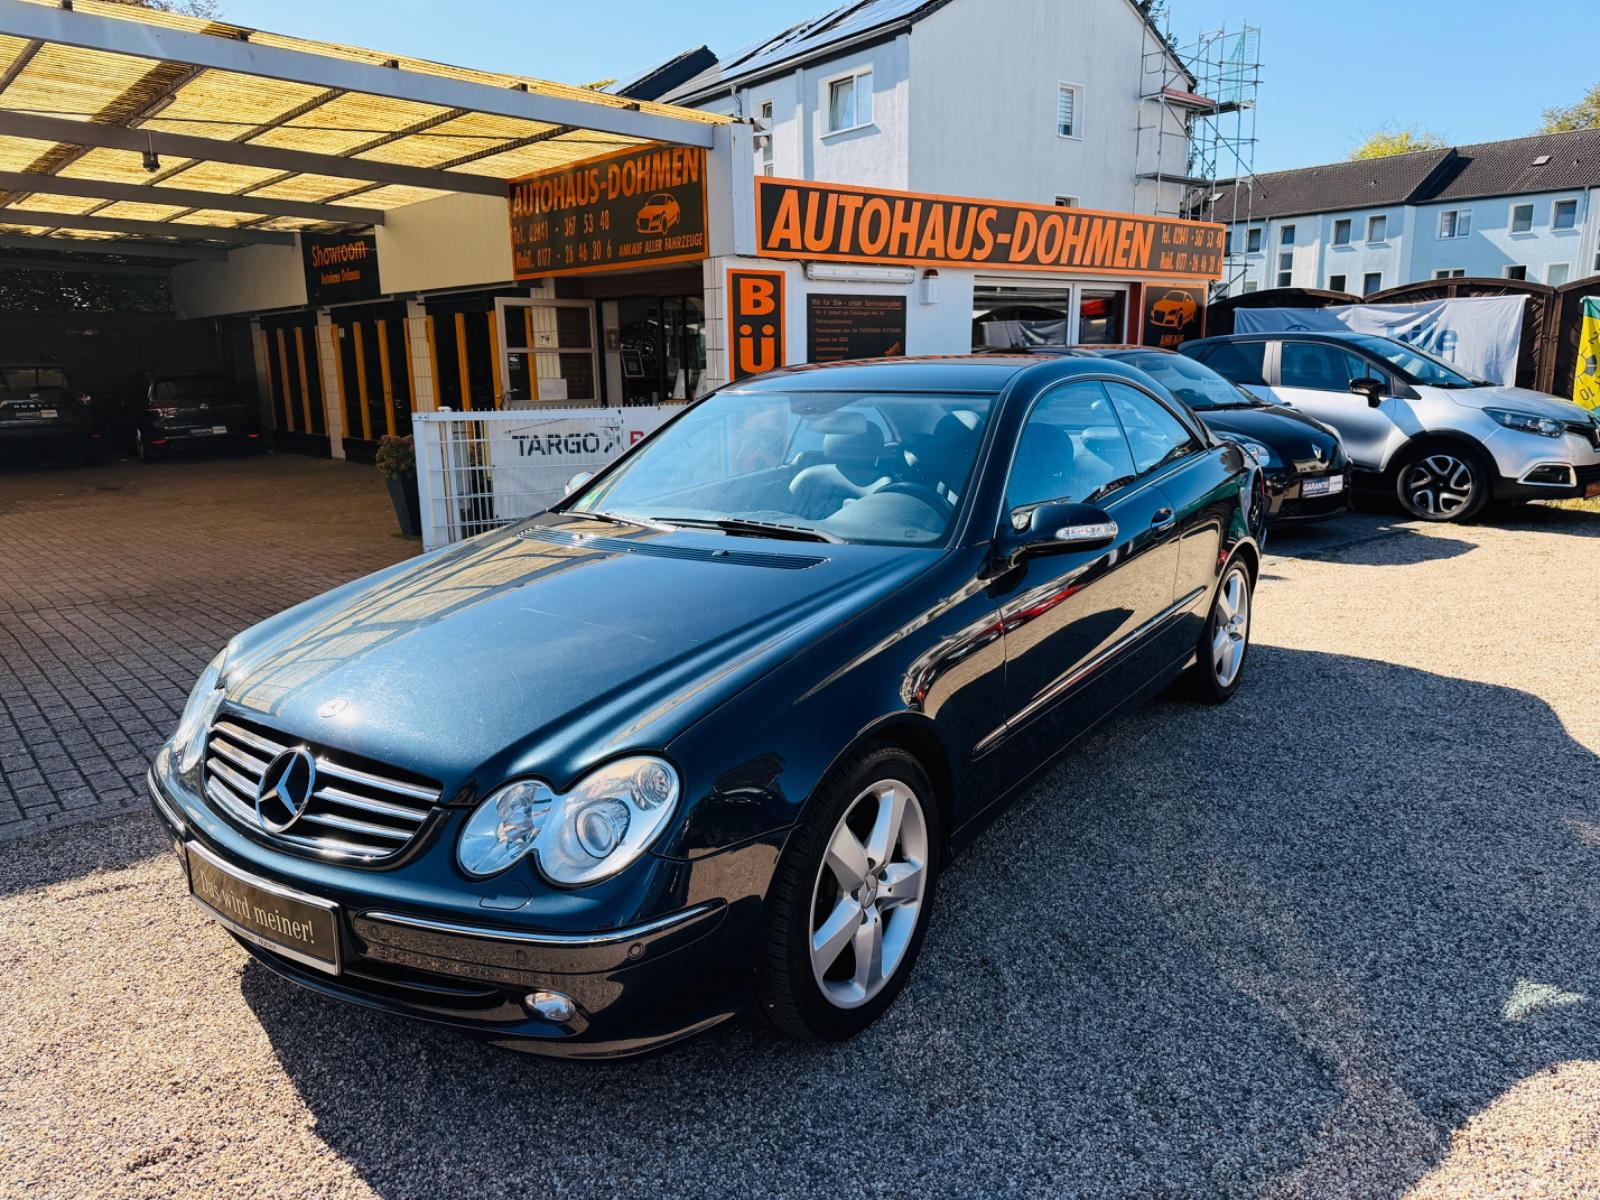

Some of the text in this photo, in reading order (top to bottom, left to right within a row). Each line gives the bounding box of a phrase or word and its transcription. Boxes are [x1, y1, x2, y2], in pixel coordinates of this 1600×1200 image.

[513, 148, 699, 218] AUTOHAUS-DOHMEN
[584, 213, 594, 234] 53
[600, 209, 610, 231] 48
[766, 189, 1155, 269] AUTOHAUS-DOHMEN
[311, 240, 367, 268] Showroom
[644, 239, 663, 254] ALLER
[664, 232, 704, 251] FAHRZEUGE
[512, 432, 600, 456] TARGO
[200, 870, 221, 901] Das
[222, 889, 252, 920] wird
[253, 905, 315, 945] meiner!
